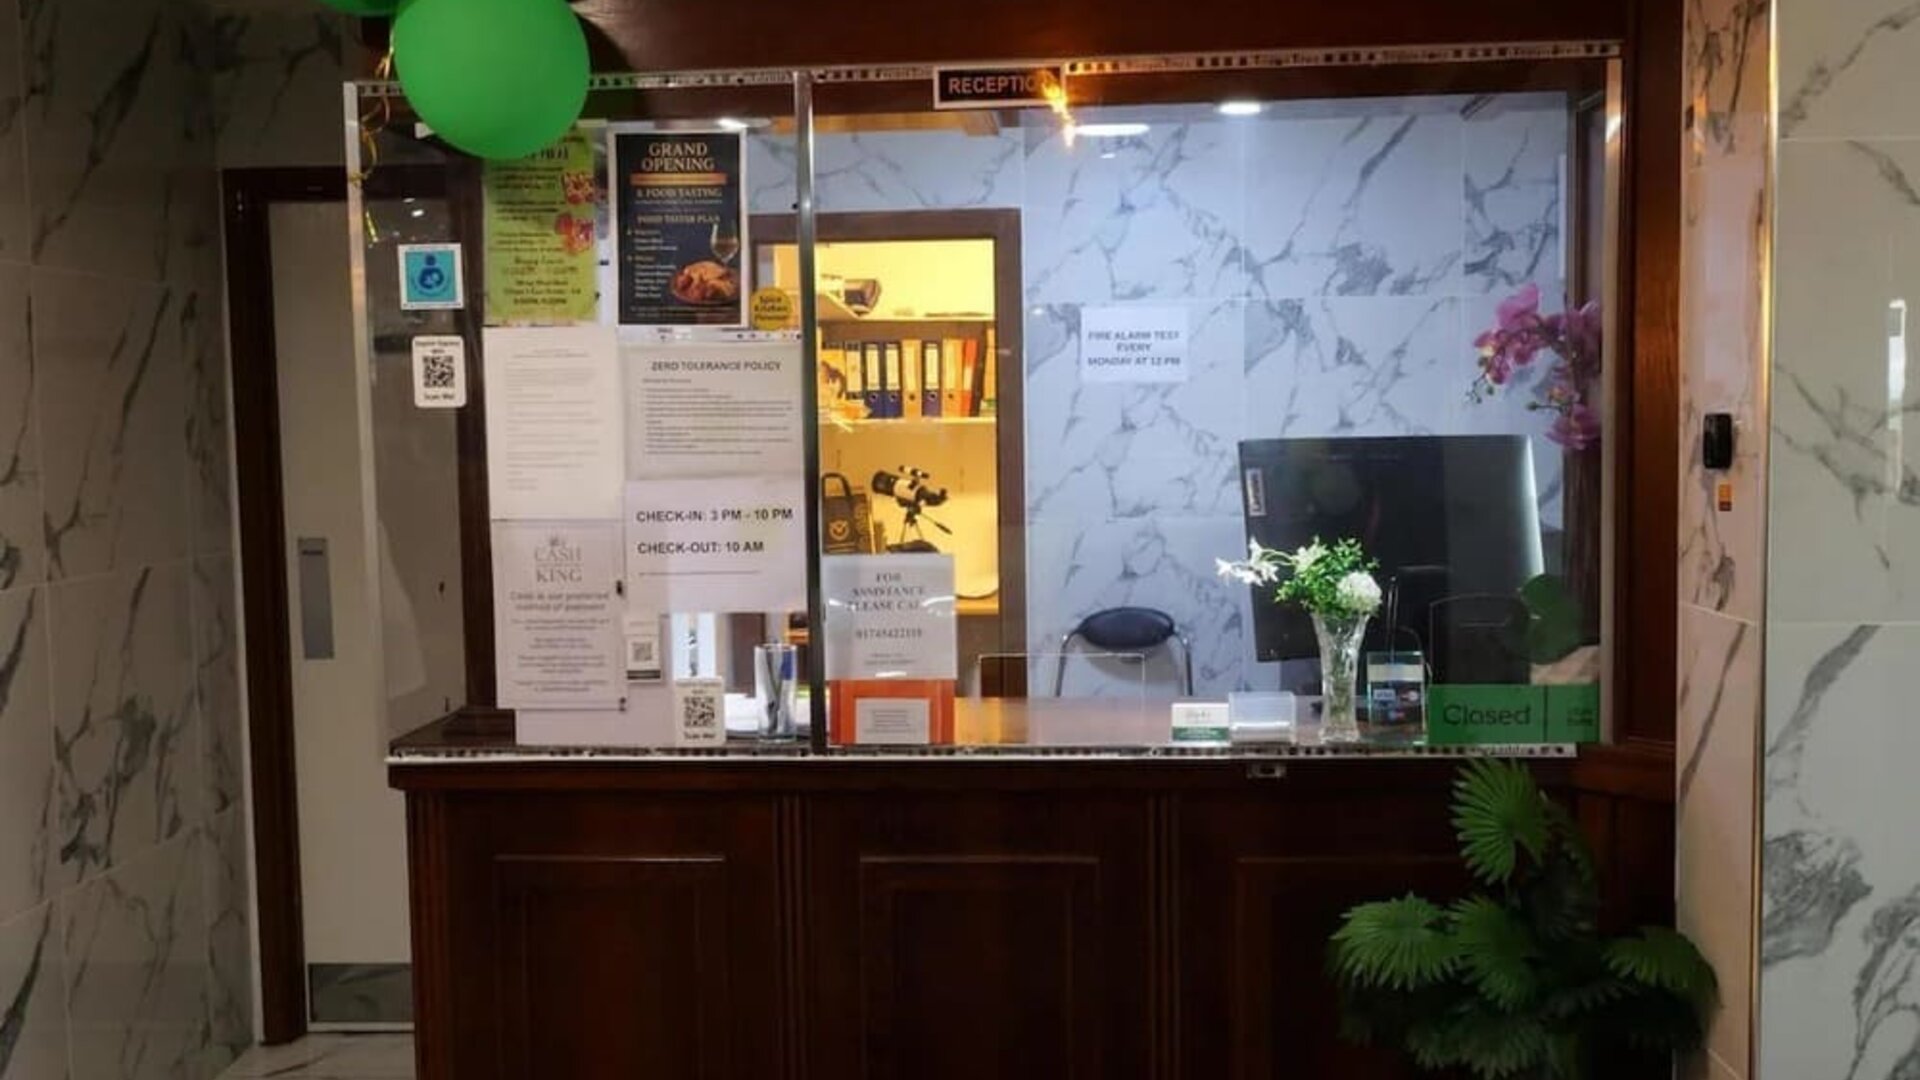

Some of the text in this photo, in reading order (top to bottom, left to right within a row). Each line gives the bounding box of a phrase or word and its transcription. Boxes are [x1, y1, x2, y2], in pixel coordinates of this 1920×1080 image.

[949, 74, 1055, 94] RECEPTIO
[648, 142, 708, 157] GRAND
[641, 157, 715, 172] OPENING
[646, 188, 677, 198] FOOD
[1088, 330, 1180, 340] FIRE ALARM TEST
[1116, 343, 1151, 352] EVERY
[651, 360, 781, 371] ZERO TOLERANCE POLICY
[1087, 357, 1131, 366] MONDAY
[1135, 357, 1150, 366] AT
[636, 510, 706, 522] CHECK-IN:
[710, 509, 718, 521] 3
[721, 508, 742, 520] PM
[754, 508, 769, 520] 10
[772, 507, 793, 520] PM
[534, 547, 582, 561] CASH
[637, 540, 764, 554] CHECK-OUT: 10 AM
[536, 568, 582, 583] KING
[876, 572, 902, 582] FOR
[852, 586, 924, 597] ASSISTANCE
[1443, 704, 1532, 726] Closed
